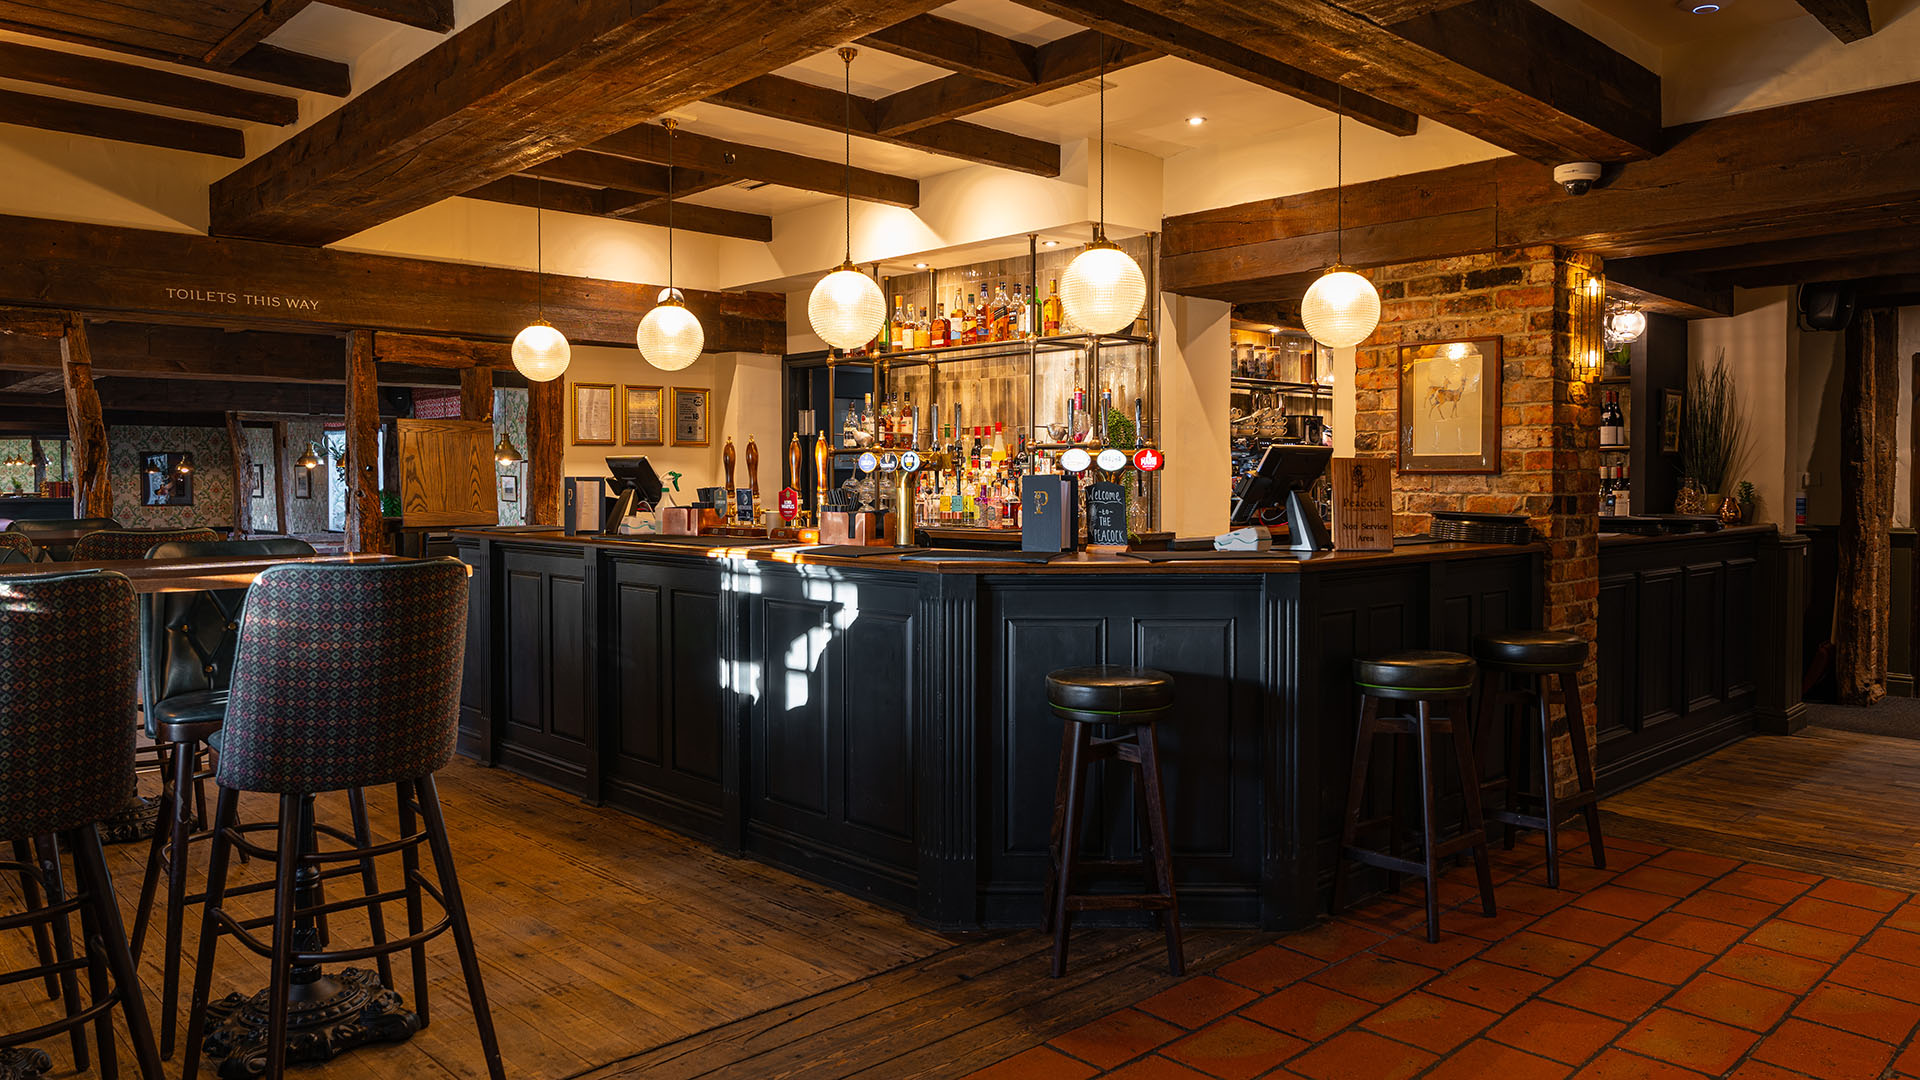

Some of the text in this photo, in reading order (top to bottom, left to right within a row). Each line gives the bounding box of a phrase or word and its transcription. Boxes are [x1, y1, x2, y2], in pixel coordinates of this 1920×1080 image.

[165, 288, 319, 311] TOILETS THIS WAY
[1086, 487, 1123, 502] Welcome
[1343, 497, 1385, 508] Peacock
[1098, 516, 1112, 527] THE
[1361, 522, 1388, 530] Service
[1093, 530, 1124, 543] PEACOCK
